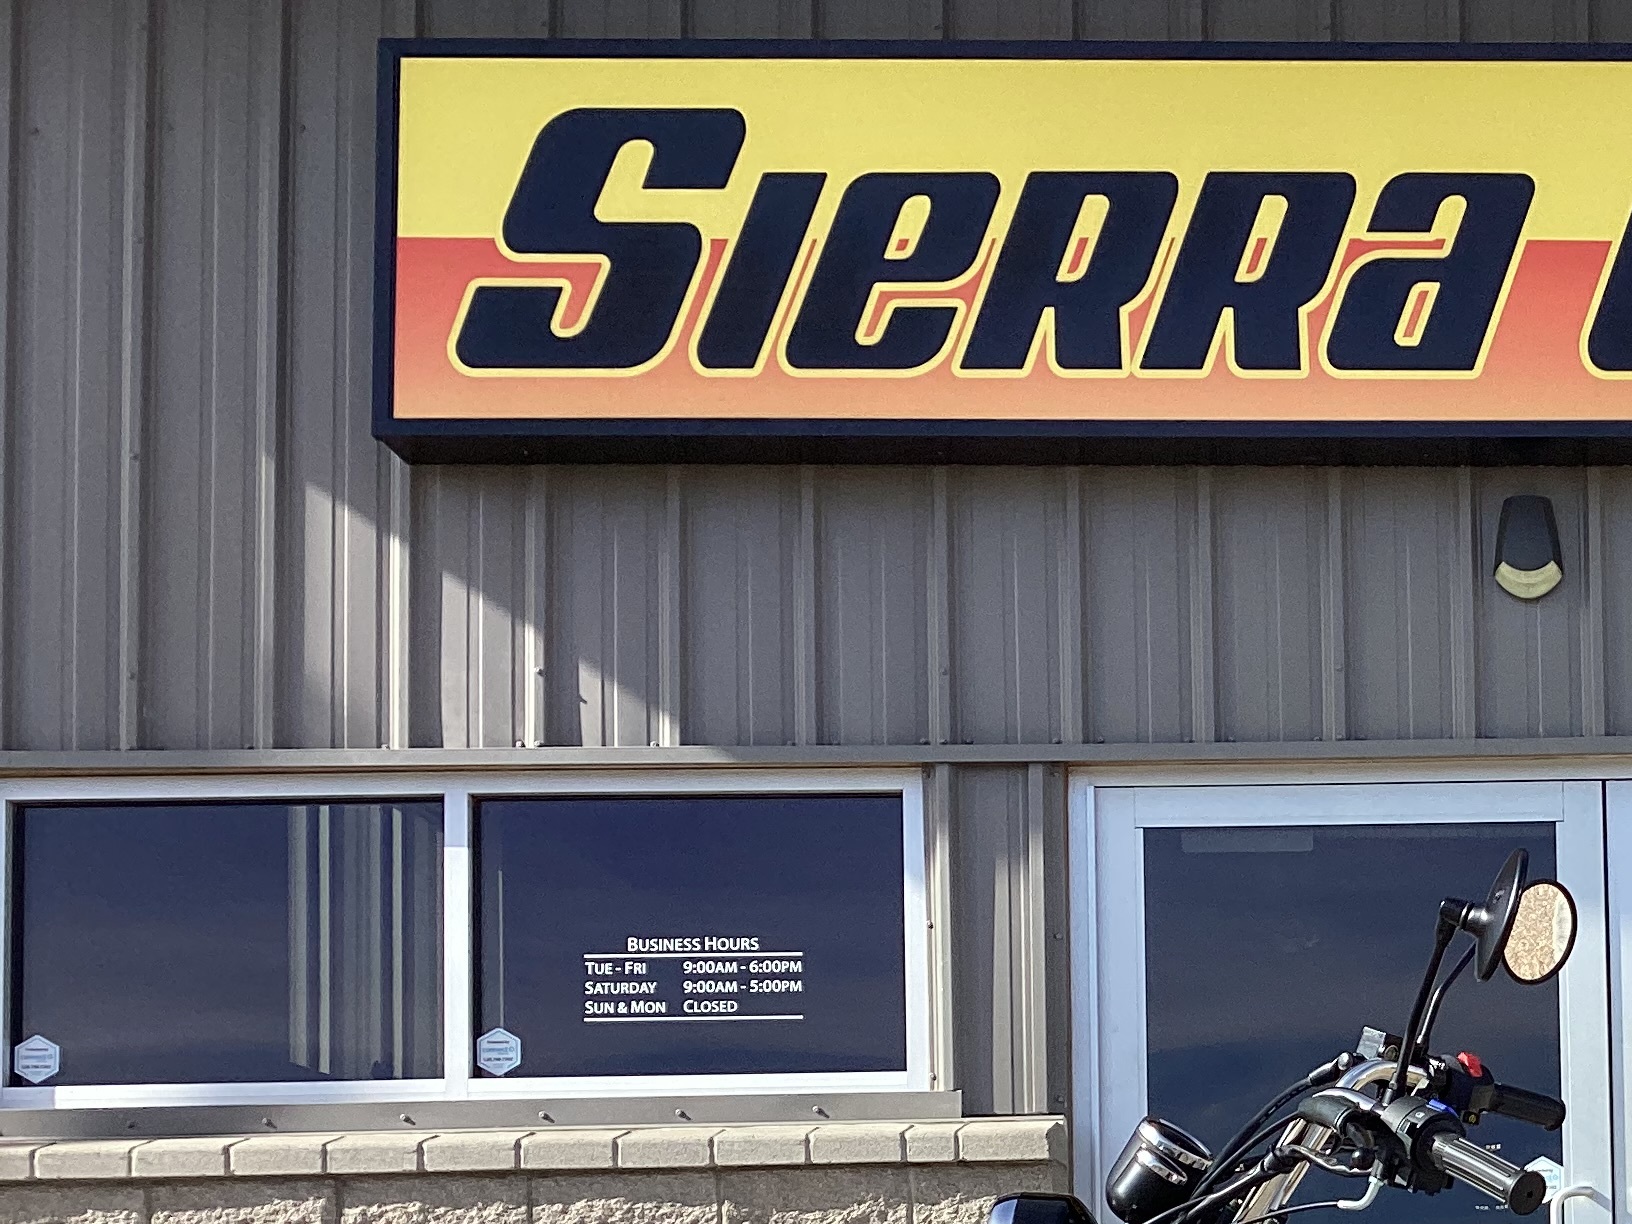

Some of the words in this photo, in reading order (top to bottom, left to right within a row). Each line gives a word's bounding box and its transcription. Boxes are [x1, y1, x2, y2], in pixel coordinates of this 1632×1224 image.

[627, 937, 701, 951] BUSINESS
[704, 936, 759, 951] HOURS
[585, 961, 613, 975] TUE
[624, 961, 647, 975] FRI
[683, 960, 738, 974] 9:00AM
[749, 959, 802, 973] 6:00PM
[584, 981, 657, 995] SATURDAY
[683, 980, 738, 994] 9:00AM
[749, 979, 802, 993] 5:00PM
[584, 1001, 614, 1014] SUN
[617, 1001, 628, 1014] &
[630, 1001, 666, 1014] MON
[683, 999, 738, 1013] CLOSED
